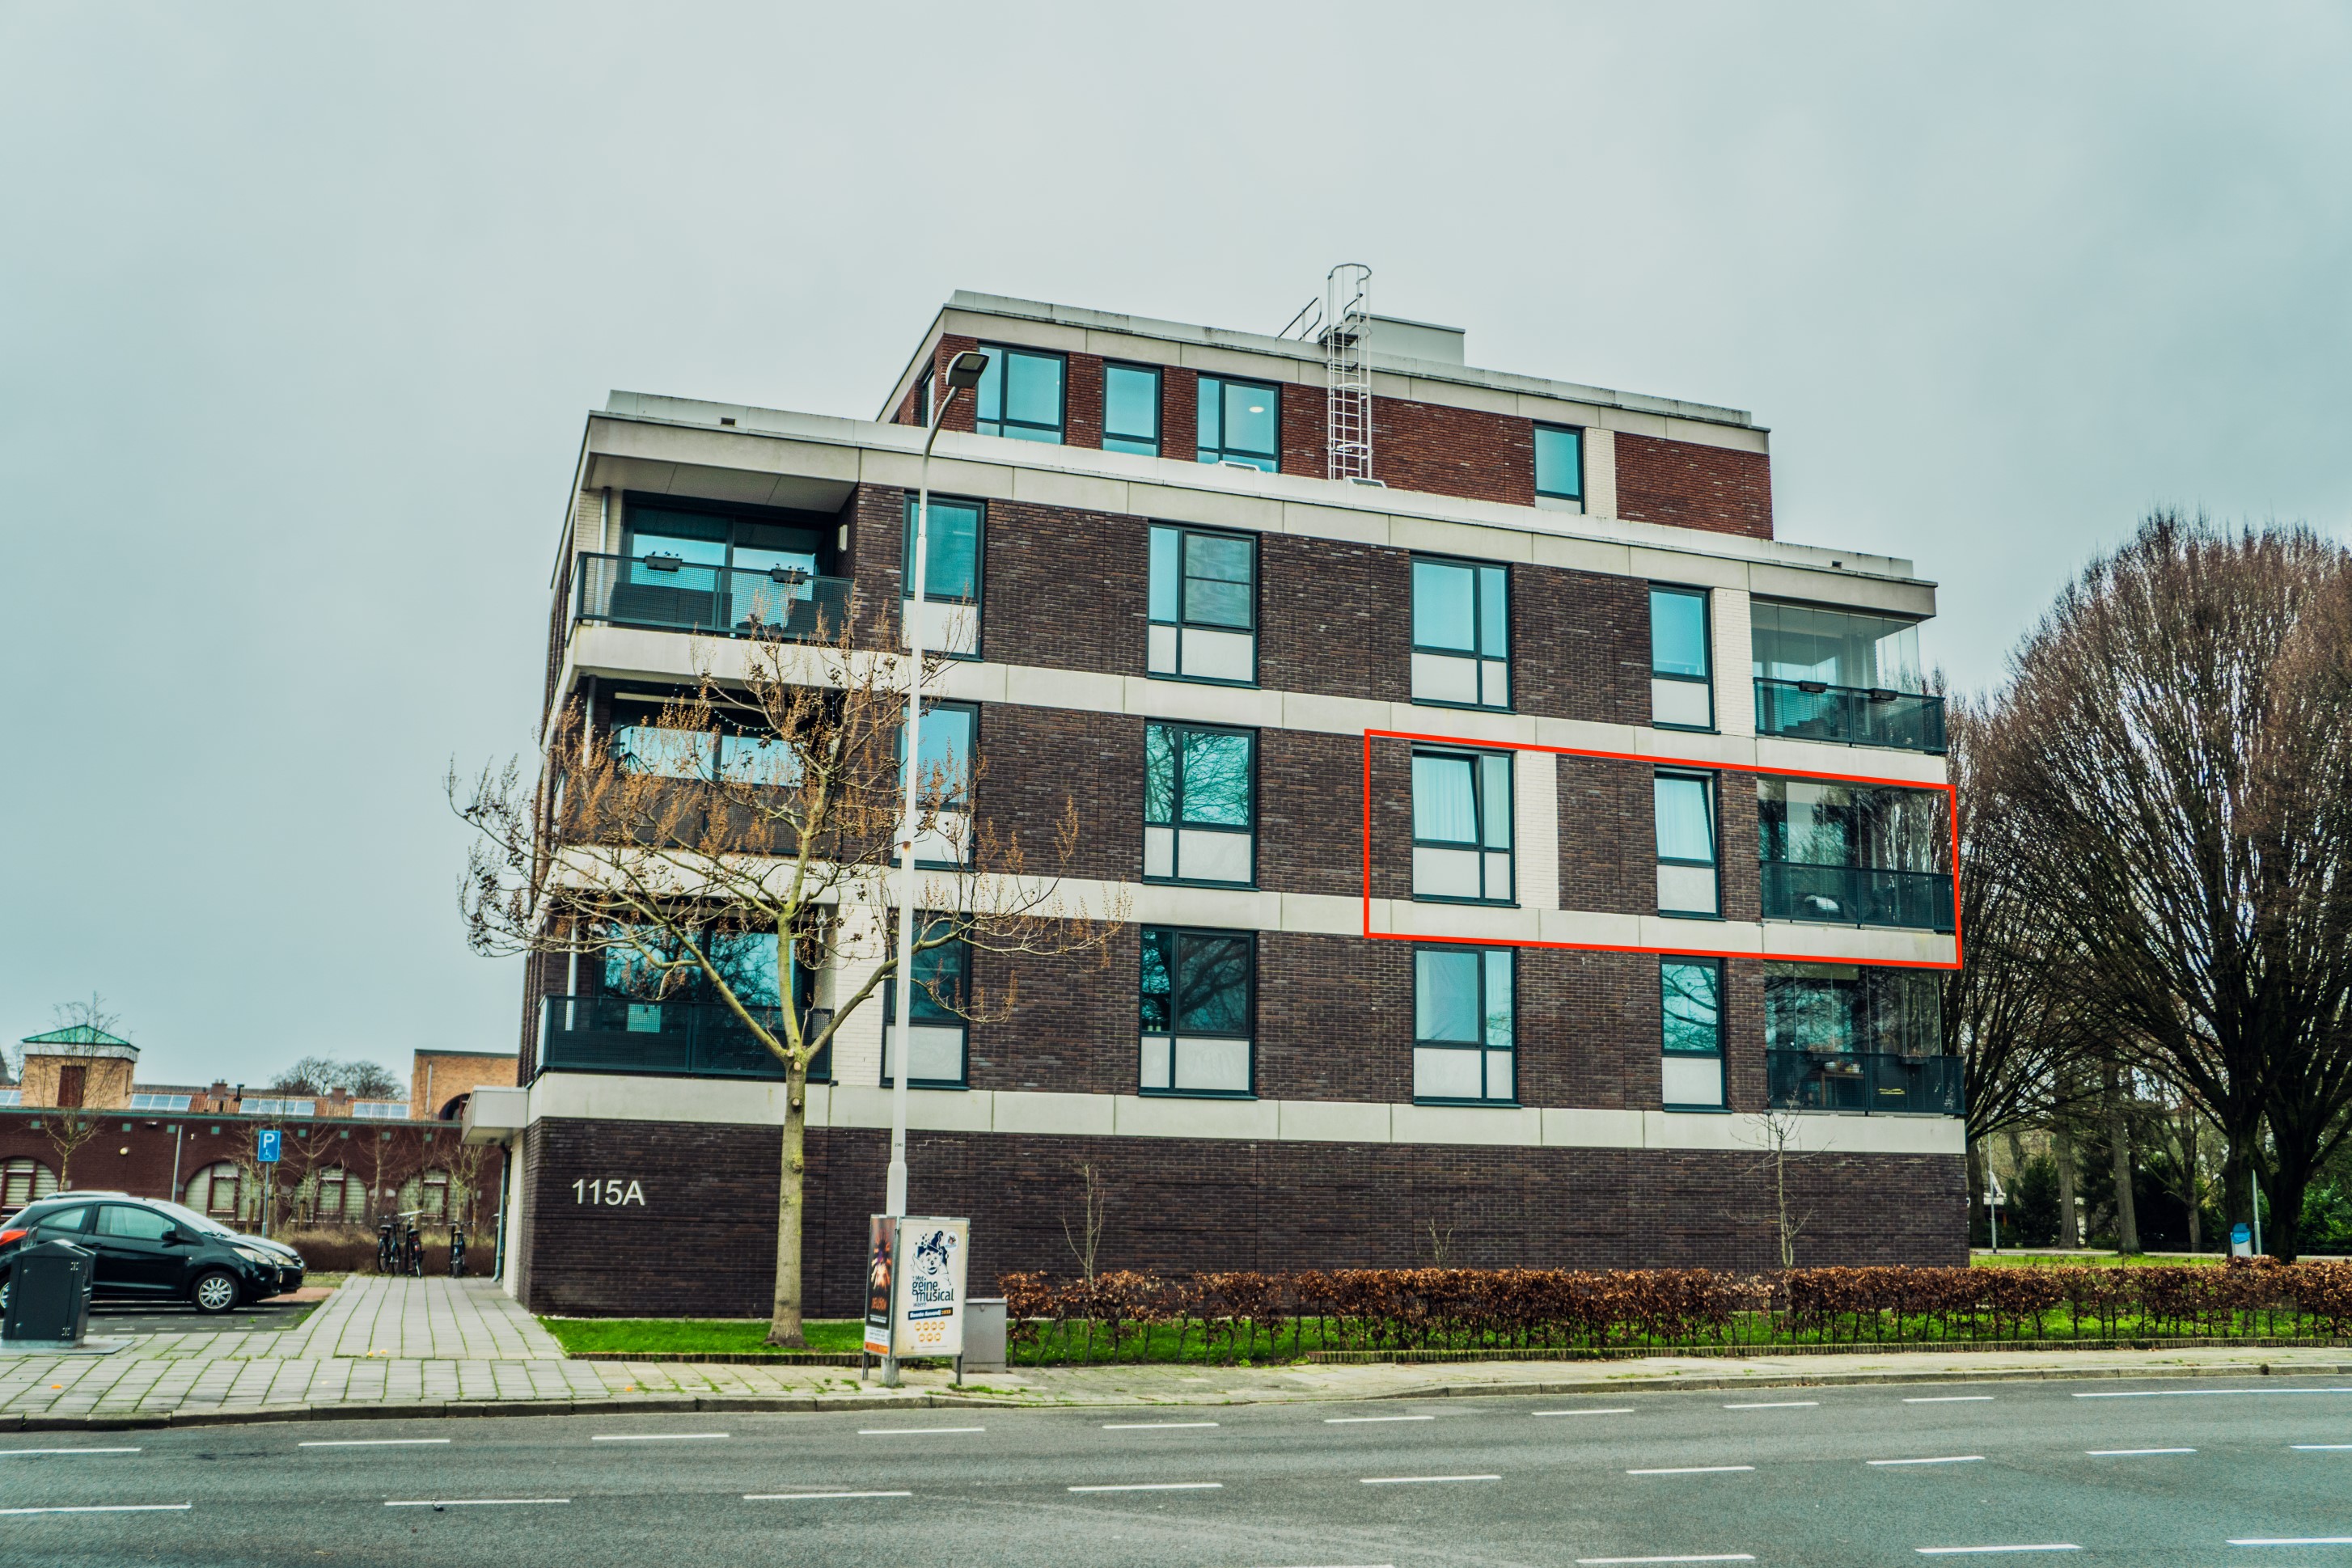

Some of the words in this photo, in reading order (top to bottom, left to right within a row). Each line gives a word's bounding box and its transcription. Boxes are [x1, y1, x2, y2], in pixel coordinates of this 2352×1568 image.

[264, 1134, 275, 1148] P
[572, 1178, 645, 1206] 115A
[912, 1278, 938, 1295] geine
[916, 1288, 954, 1302] musical
